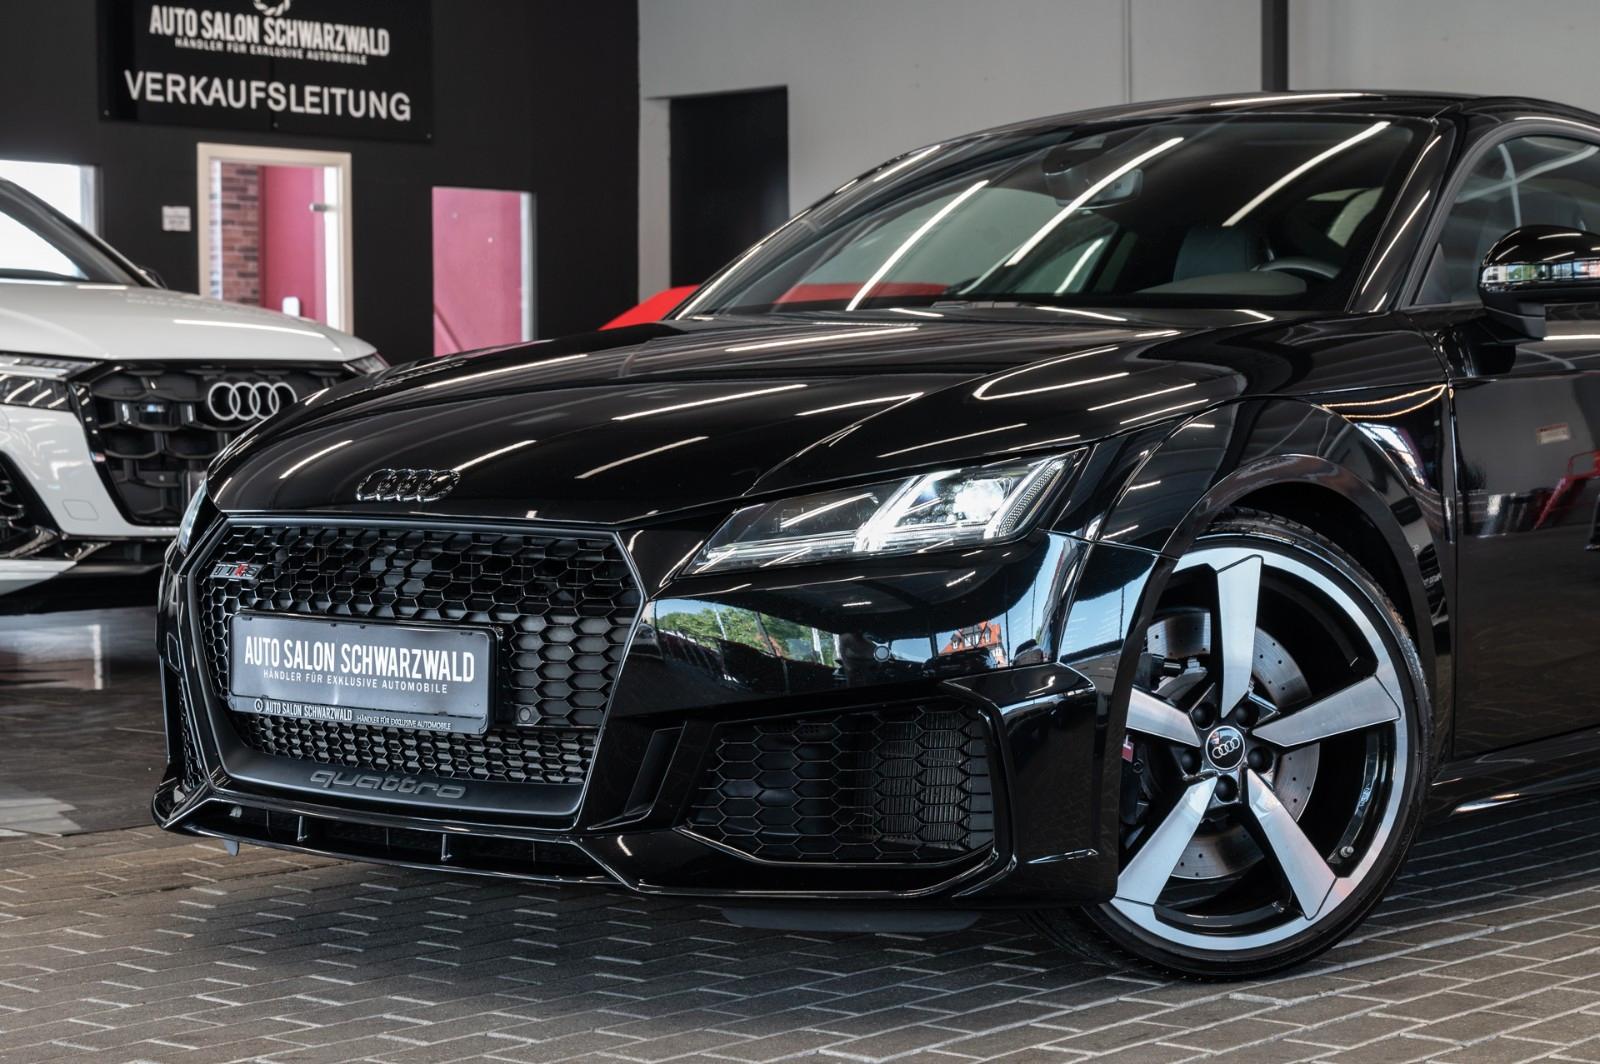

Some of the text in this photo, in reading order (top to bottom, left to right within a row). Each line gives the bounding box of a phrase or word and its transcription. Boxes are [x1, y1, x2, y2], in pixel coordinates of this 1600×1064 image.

[149, 4, 390, 57] AUTO SALON SCHWARZWALD
[306, 49, 368, 66] AUTOMOBILE
[124, 69, 411, 121] VERKAUFSLEITUNG
[244, 635, 475, 683] AUTO SALON SCHWARZWALD
[263, 669, 448, 694] HÄNDLER FÜR EXKLUSIVE AUTOMOBILE
[265, 700, 353, 721] AUTO SALON SCHWARZWALD
[310, 769, 466, 799] quattro
